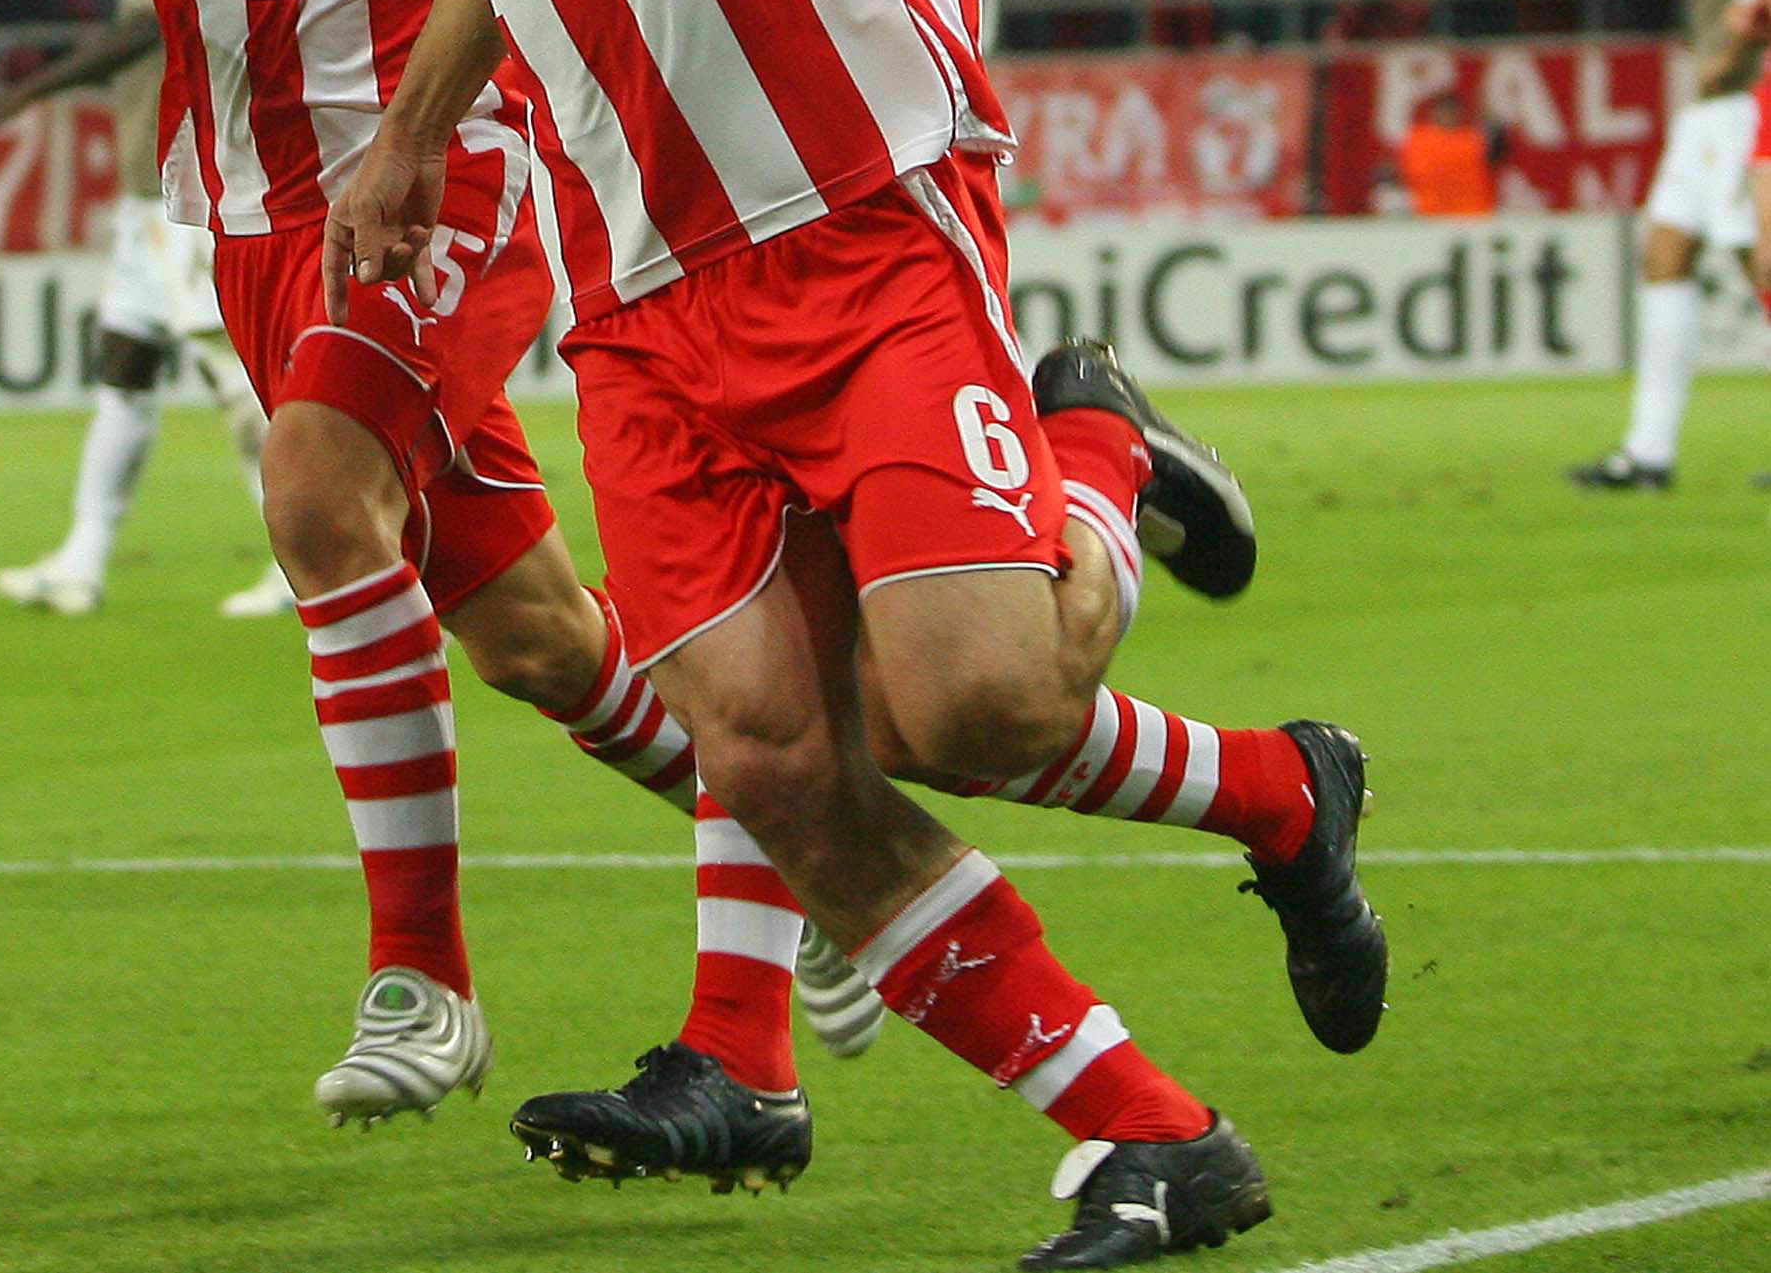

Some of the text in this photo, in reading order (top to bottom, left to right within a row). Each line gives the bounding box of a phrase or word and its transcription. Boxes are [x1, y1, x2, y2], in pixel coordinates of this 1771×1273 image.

[408, 224, 486, 317] 5
[1008, 235, 1581, 367] niCredit
[953, 384, 1031, 491] 6
